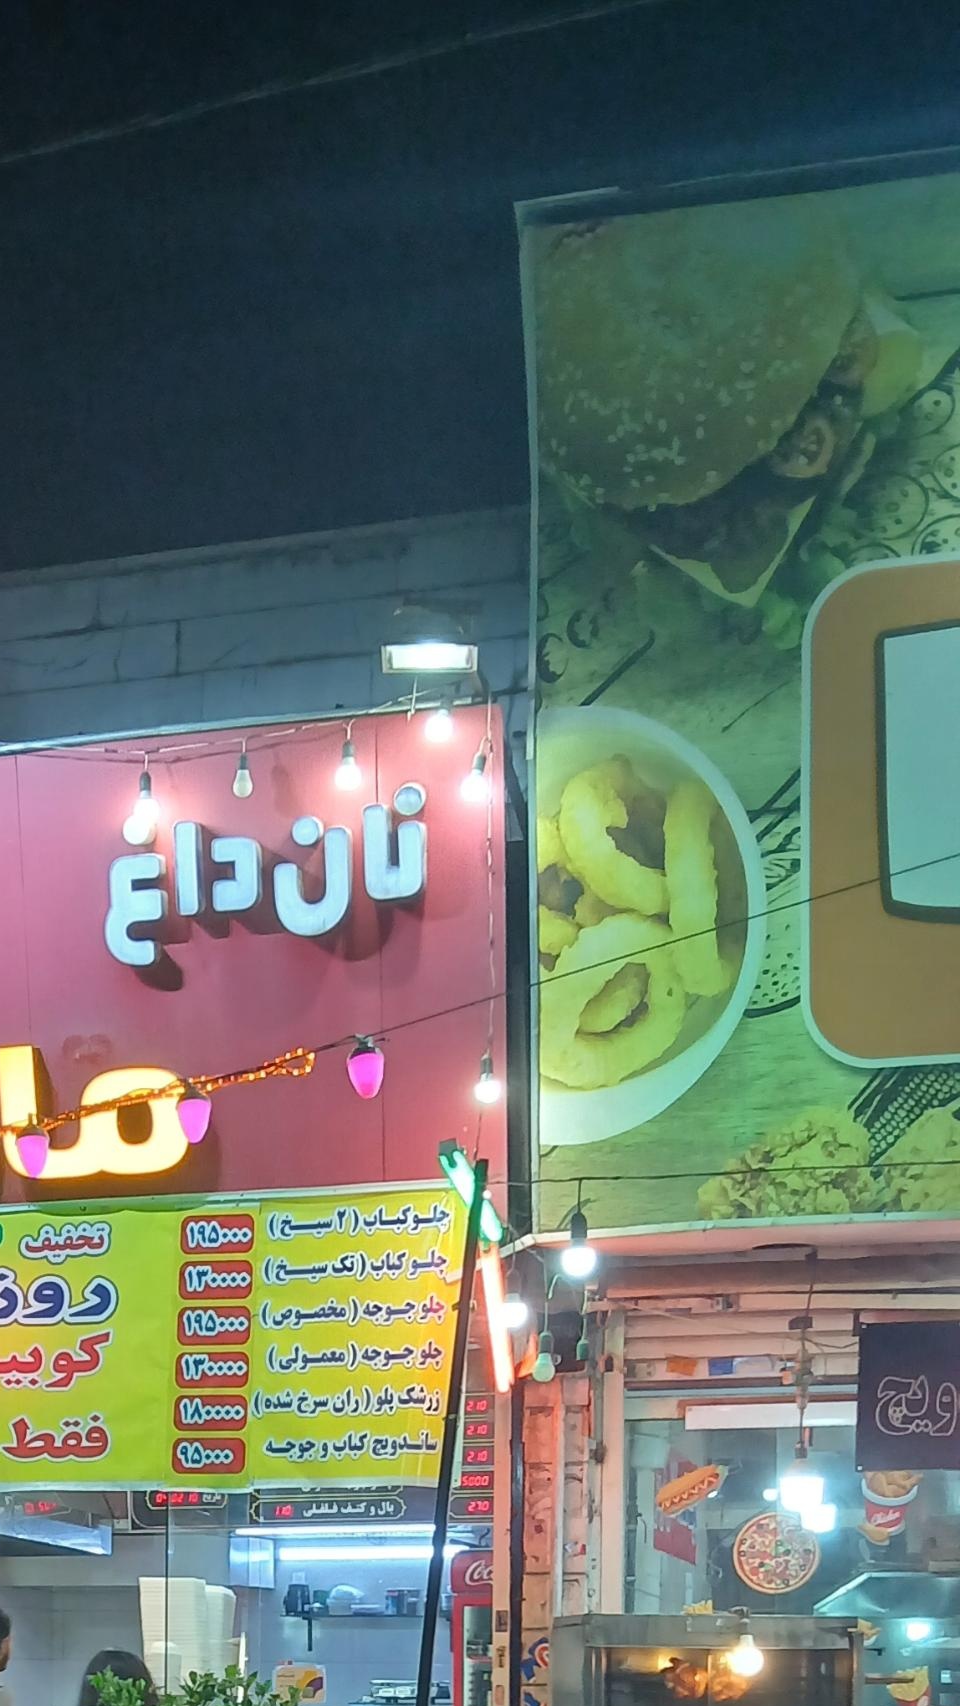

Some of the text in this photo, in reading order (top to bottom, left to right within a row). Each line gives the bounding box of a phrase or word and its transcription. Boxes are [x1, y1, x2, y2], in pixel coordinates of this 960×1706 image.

[104, 782, 428, 967] نان داغ
[22, 1224, 108, 1260] تخفیف
[187, 1222, 251, 1247] ۱۹۵۰۰۰
[369, 1250, 408, 1279] کباب
[186, 1266, 249, 1291] ۱۳۰۰۰۰
[184, 1310, 247, 1335] ۱۹۵۰۰۰
[362, 1301, 417, 1325] جوجه
[183, 1355, 246, 1379] ۱۳۰۰۰۰
[360, 1345, 415, 1369] جوجه
[296, 1390, 330, 1413] سرخ
[374, 1385, 395, 1413] پلو
[397, 1385, 441, 1412] زرشک
[181, 1399, 243, 1424] ۱۸۰۰۰۰
[0, 1412, 111, 1461] فقط
[264, 1430, 438, 1461] ساندویچ کباب و جوجه
[178, 1443, 232, 1467] ۹۵۰۰۰
